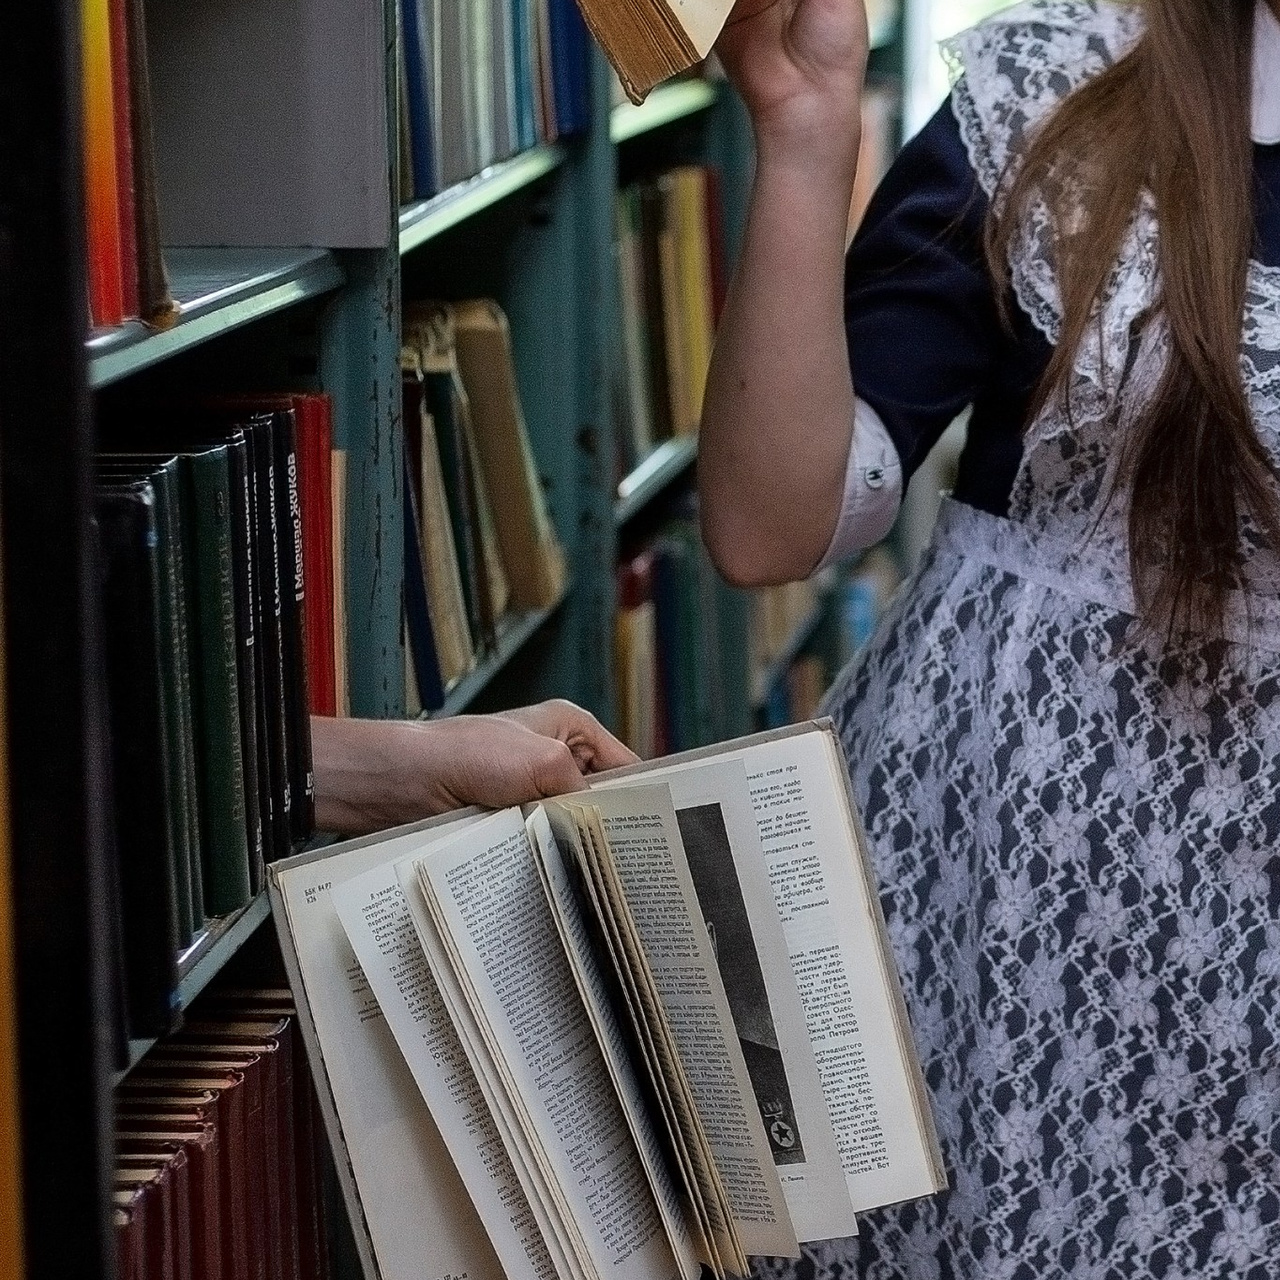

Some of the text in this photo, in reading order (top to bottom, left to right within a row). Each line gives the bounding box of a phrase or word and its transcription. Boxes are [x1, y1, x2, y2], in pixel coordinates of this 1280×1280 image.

[286, 451, 299, 517] ЖУКОВ
[798, 971, 820, 981] части
[813, 985, 831, 995] порт
[800, 991, 841, 1005] 26 августа,
[802, 997, 852, 1011] Генерального
[805, 1009, 830, 1019] совета
[819, 1016, 833, 1024] для
[832, 1019, 858, 1029] сектор
[828, 1025, 859, 1038] Петрова
[824, 1057, 866, 1070] километров
[848, 1072, 869, 1082] вчера
[833, 1091, 855, 1100] очень
[837, 1121, 858, 1131] части
[859, 1131, 883, 1142] вашем
[845, 1148, 887, 1160] противника
[876, 1160, 890, 1169] Вот
